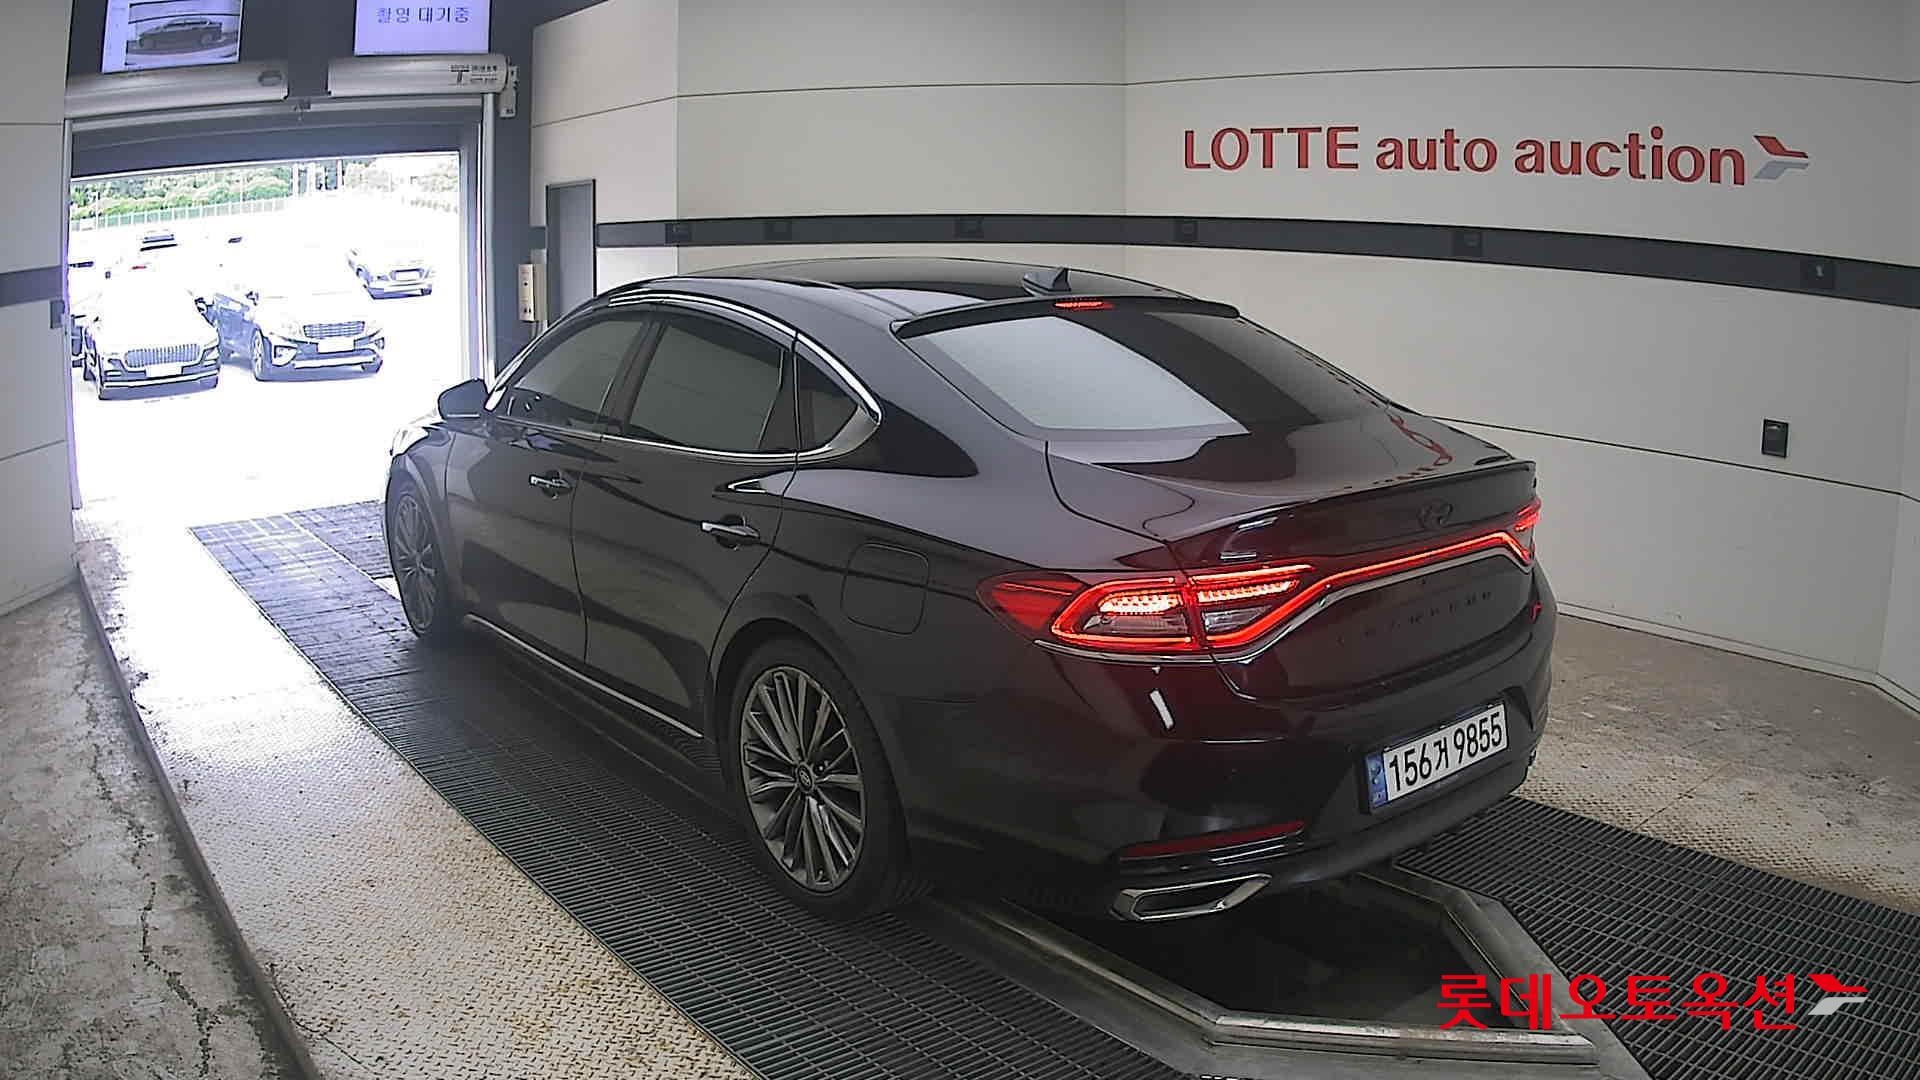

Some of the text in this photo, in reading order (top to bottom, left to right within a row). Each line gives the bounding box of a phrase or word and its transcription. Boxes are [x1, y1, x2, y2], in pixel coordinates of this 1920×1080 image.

[418, 6, 469, 24] 대기중
[1185, 126, 1746, 186] LOTTE auto auction
[1389, 711, 1502, 791] 156거 9855
